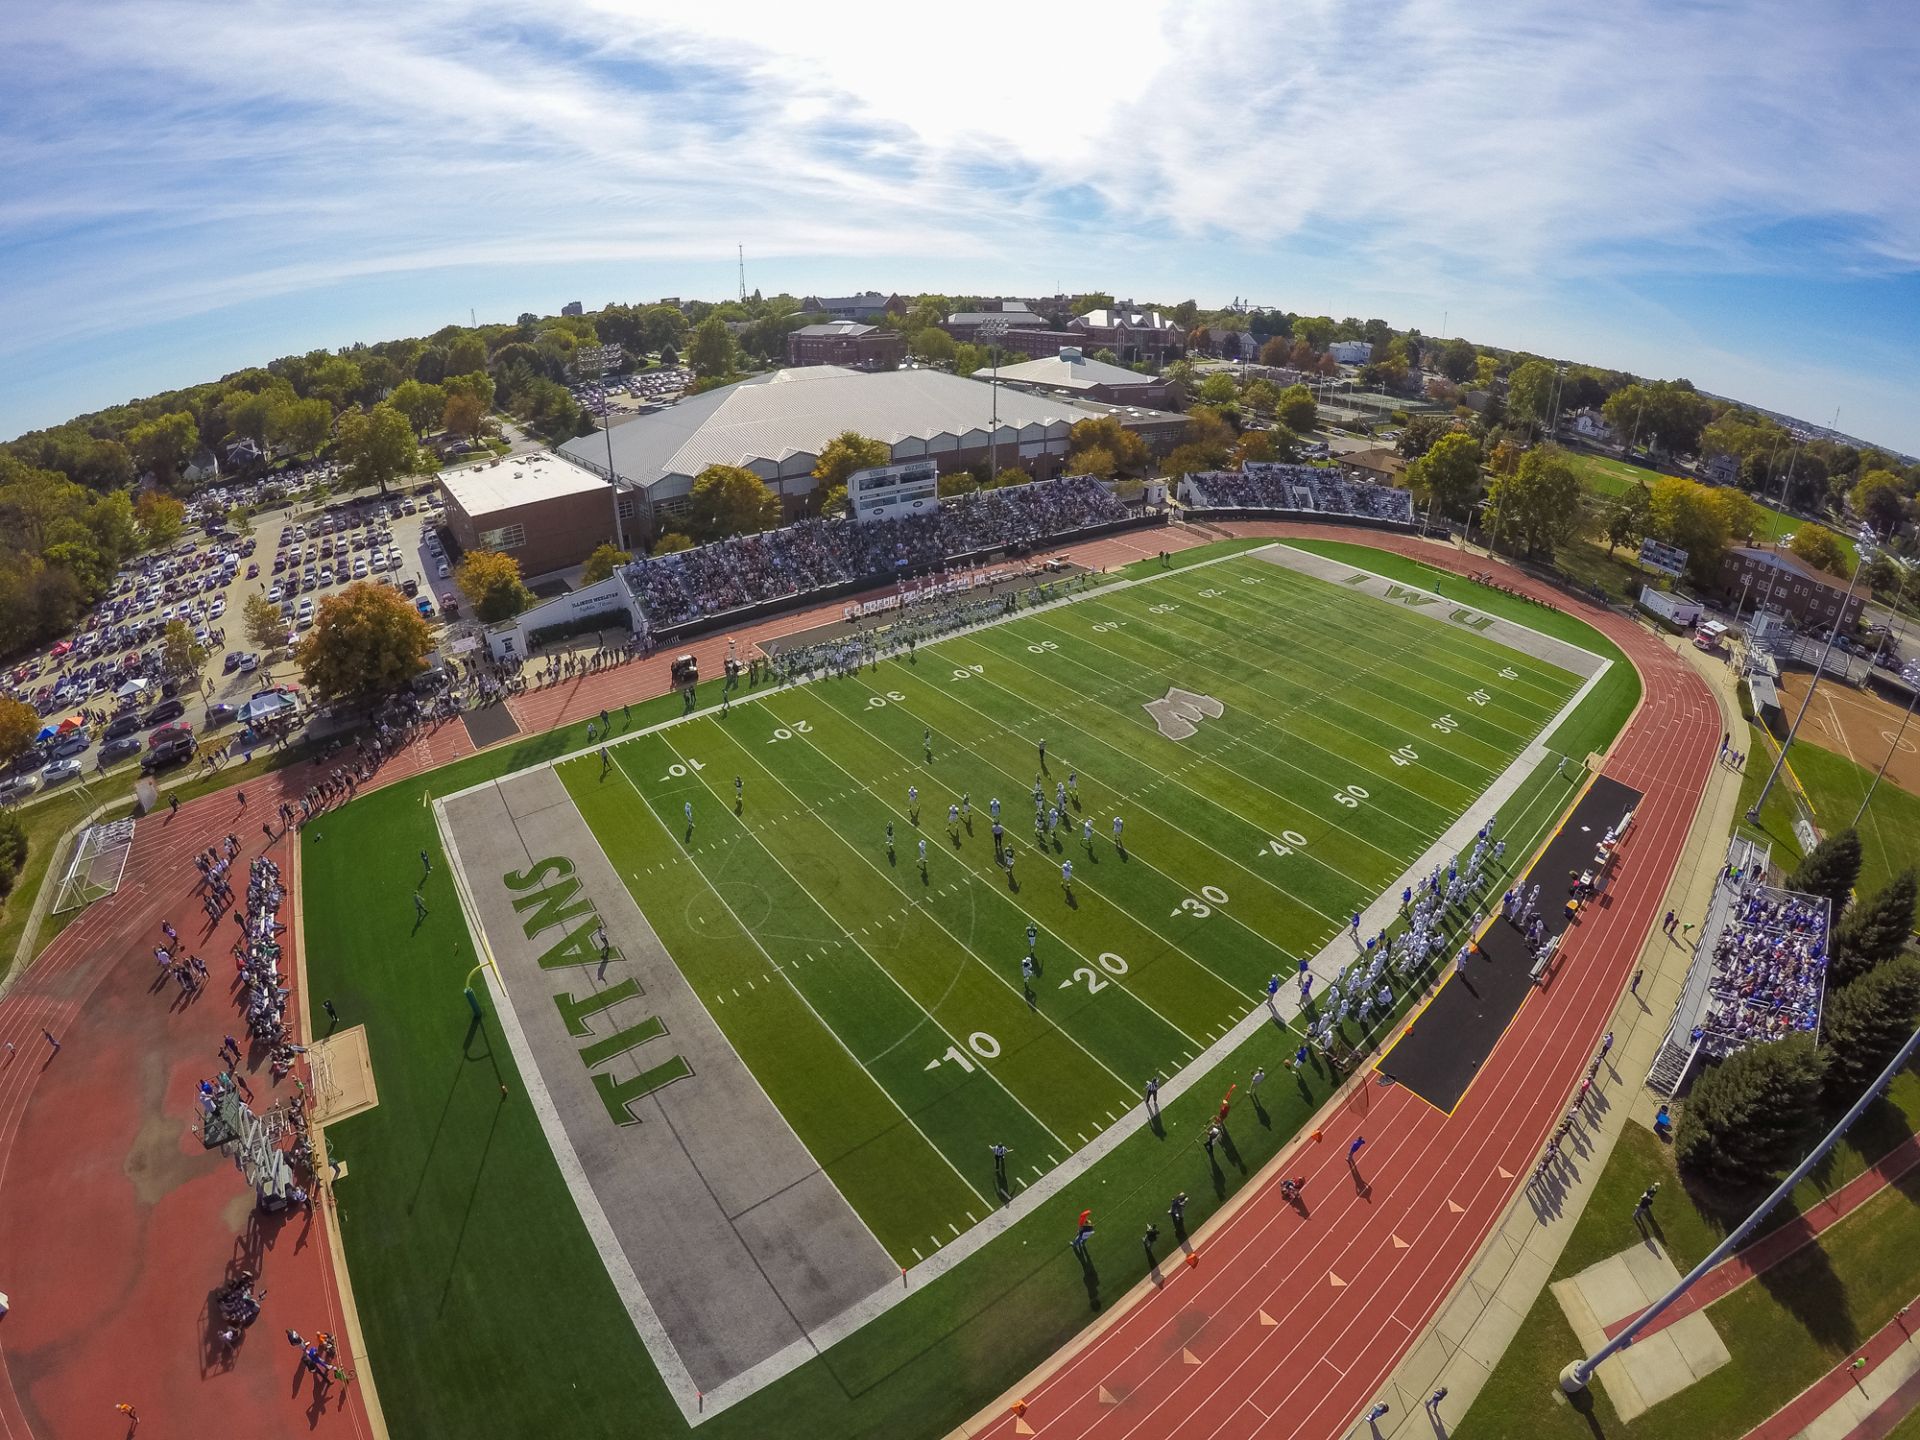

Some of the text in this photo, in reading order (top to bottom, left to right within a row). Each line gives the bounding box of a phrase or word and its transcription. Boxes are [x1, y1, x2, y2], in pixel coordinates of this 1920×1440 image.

[1198, 588, 1222, 598] 20
[1149, 604, 1175, 614] 30
[1092, 621, 1119, 633] 40
[1027, 640, 1060, 654] 50
[953, 664, 984, 679] 40
[1498, 667, 1519, 681] 10
[869, 691, 906, 708] 30
[1466, 690, 1491, 706] 20
[773, 720, 814, 740] 20
[1431, 716, 1459, 734] 30
[1389, 747, 1419, 767] 40
[668, 758, 707, 777] 10
[1333, 785, 1370, 808] 50
[1269, 830, 1308, 857] 40
[1181, 885, 1230, 919] 30
[1073, 952, 1129, 995] 20
[503, 855, 697, 1128] TITANS
[942, 1031, 1001, 1074] 10
